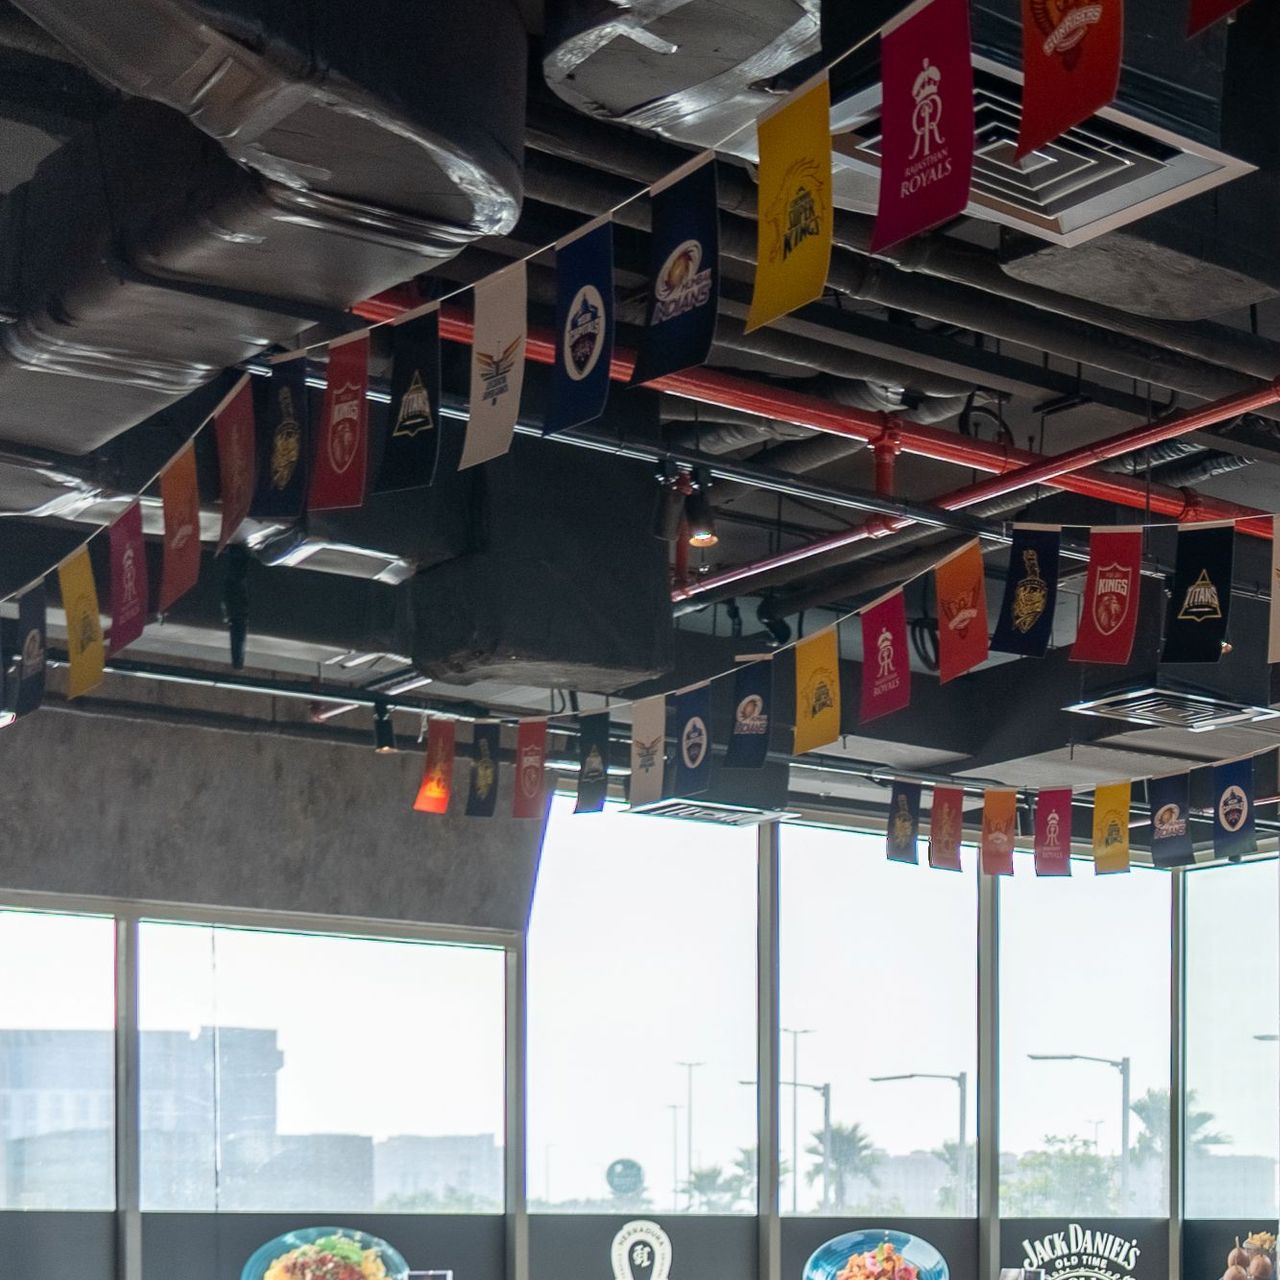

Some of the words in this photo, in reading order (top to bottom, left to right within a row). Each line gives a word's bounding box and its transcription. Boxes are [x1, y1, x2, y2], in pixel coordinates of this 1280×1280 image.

[904, 148, 949, 176] RAJASTHAN
[900, 158, 952, 198] ROYALS
[1098, 579, 1128, 596] KINGS
[618, 1228, 664, 1247] HERRADURA
[1022, 1232, 1069, 1269] JACK
[1068, 1223, 1140, 1270] DANIEL'S
[1055, 1257, 1079, 1269] OLD
[1082, 1256, 1107, 1269] TIME
